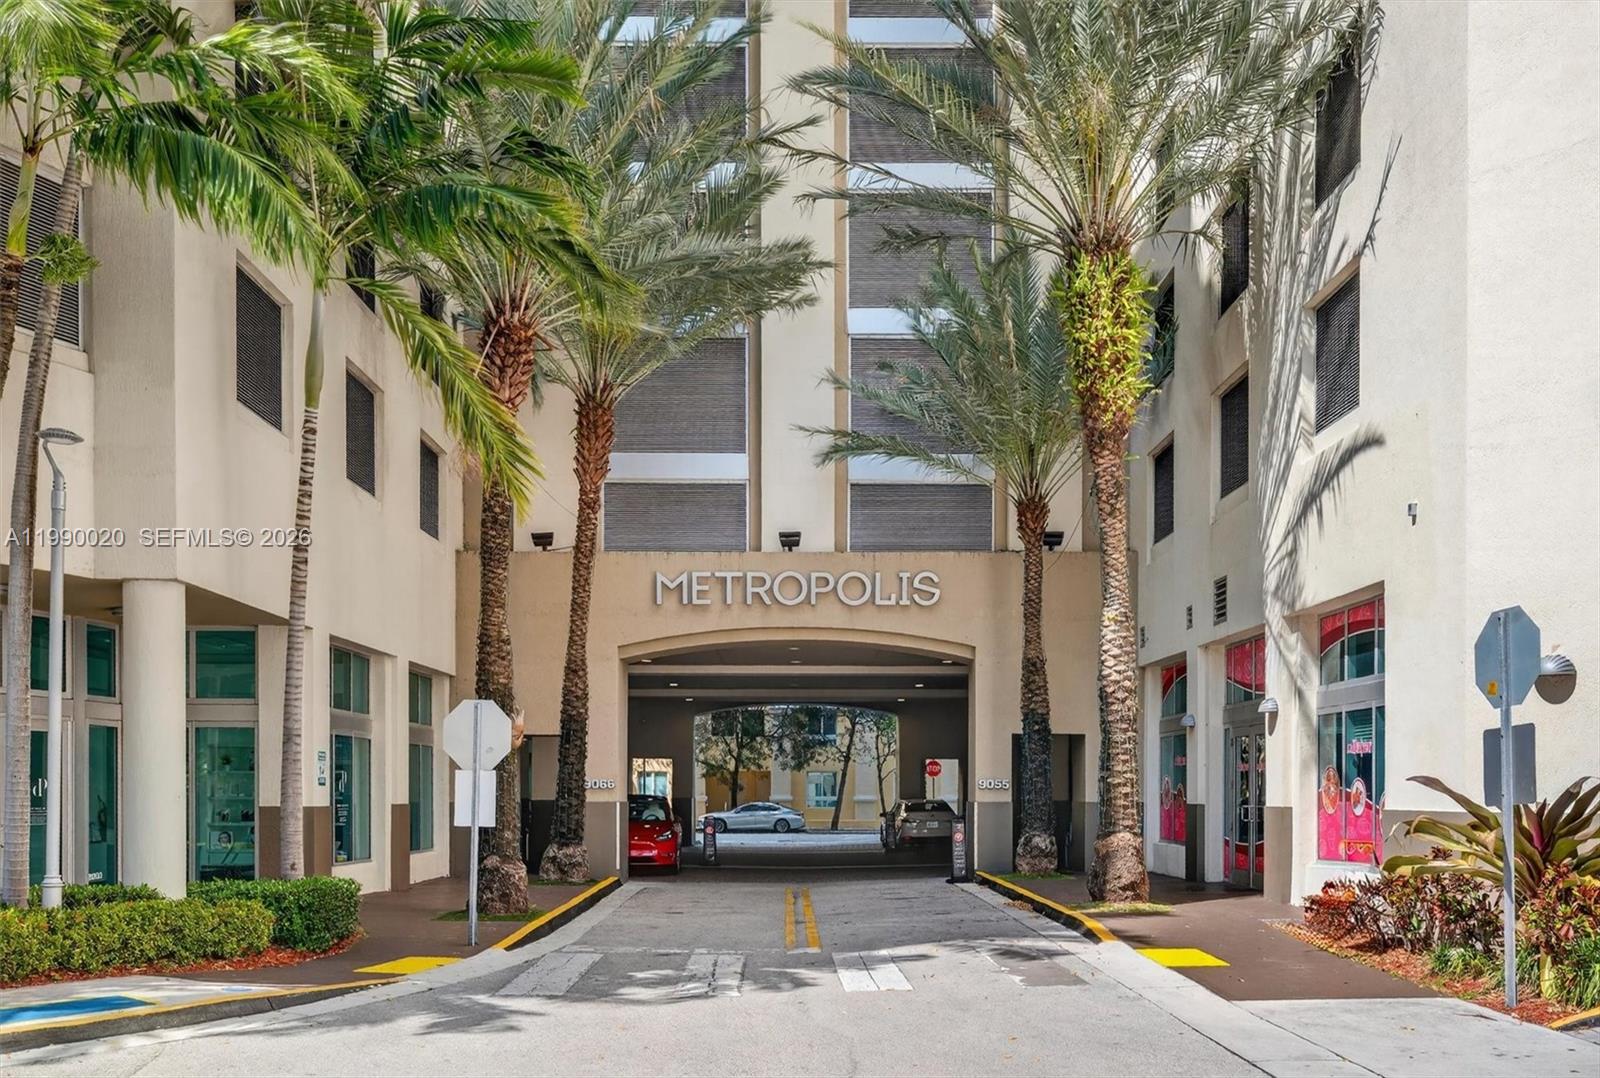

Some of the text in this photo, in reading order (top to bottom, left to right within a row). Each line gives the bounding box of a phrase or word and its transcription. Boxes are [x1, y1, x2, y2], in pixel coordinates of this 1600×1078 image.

[655, 570, 941, 606] METROPOLIS
[584, 779, 615, 789] 9066
[978, 779, 1010, 789] 9055
